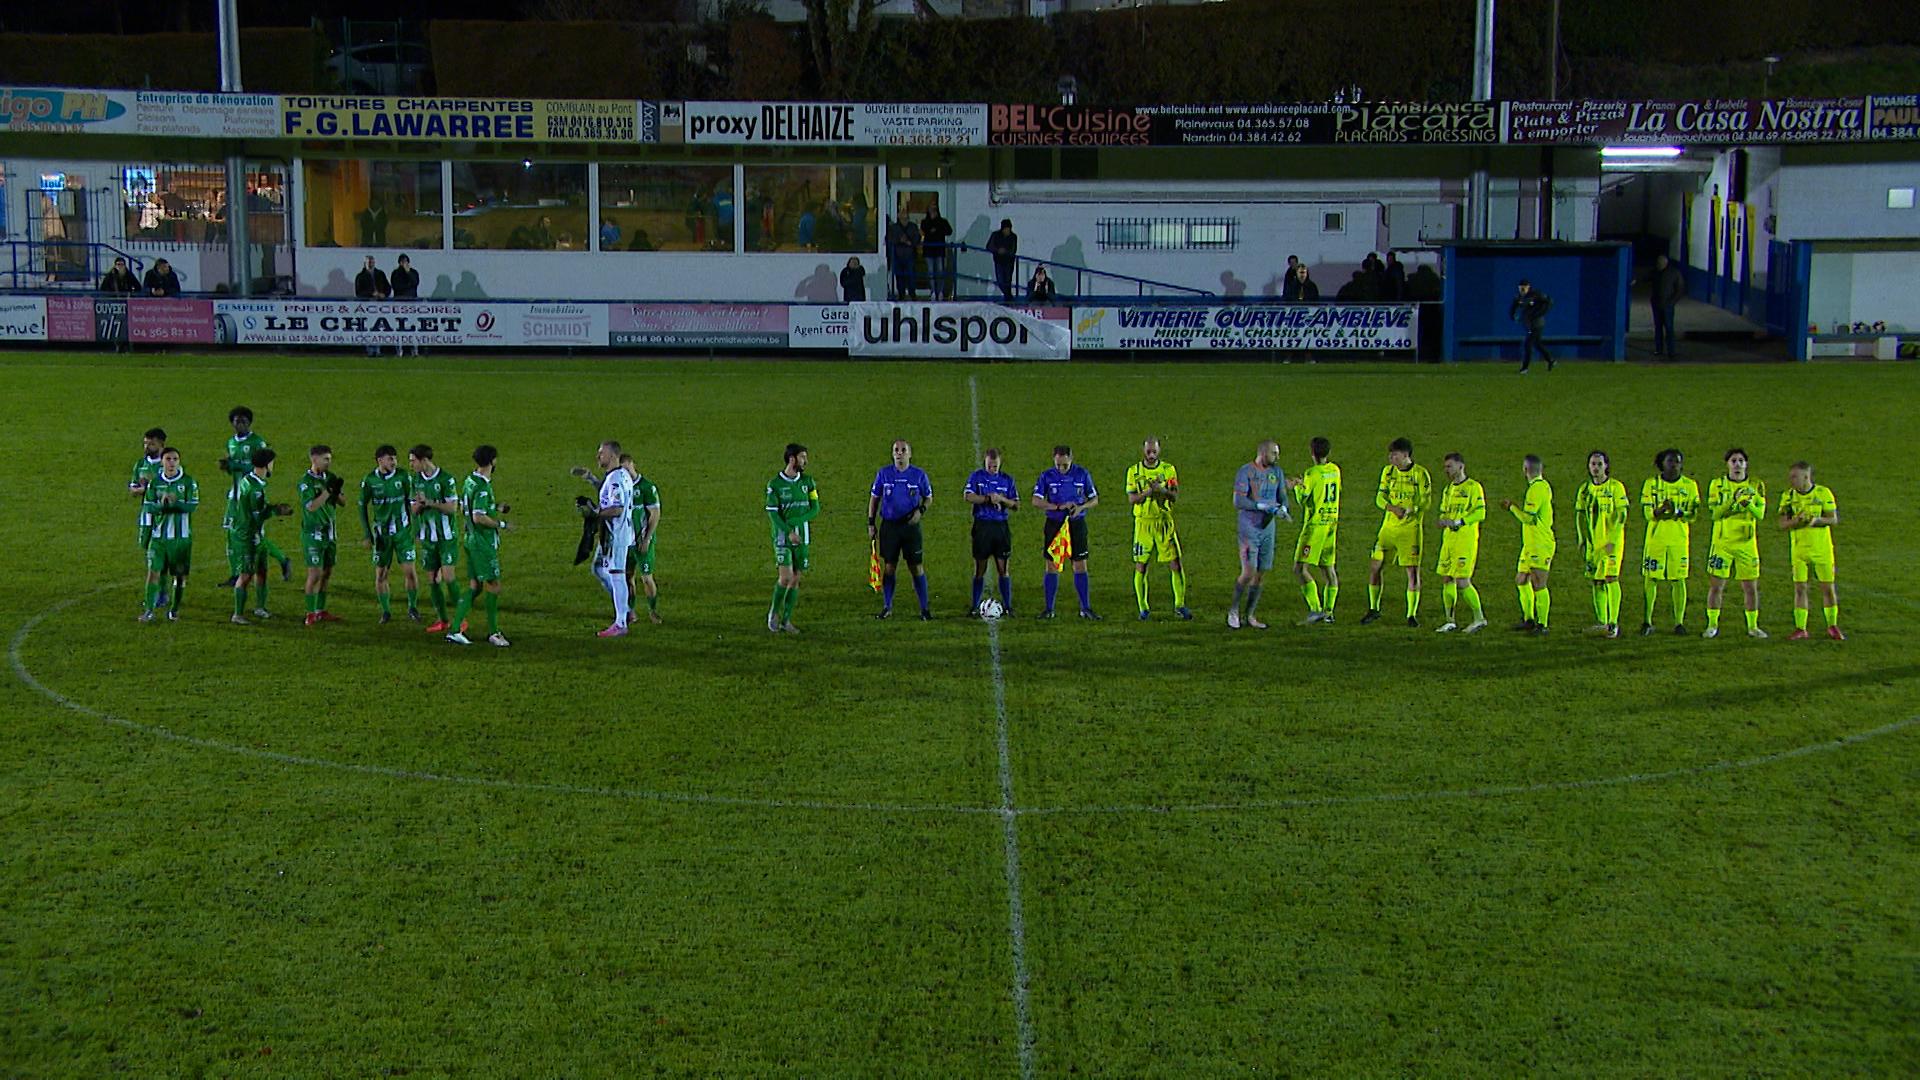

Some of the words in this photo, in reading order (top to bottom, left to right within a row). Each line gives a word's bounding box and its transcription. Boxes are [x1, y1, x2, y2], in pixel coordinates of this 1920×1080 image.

[136, 91, 194, 105] Entreprise
[196, 95, 210, 104] de
[1873, 96, 1917, 107] VIDANGE
[285, 97, 386, 110] TOITURES
[397, 100, 534, 113] CHARPENTES
[865, 105, 900, 114] OUVERT
[903, 105, 911, 114] le
[913, 105, 954, 114] dimanche
[957, 106, 980, 114] matin
[1374, 102, 1486, 114] AMBIANCE
[1511, 100, 1573, 112] Restaurant
[641, 100, 656, 142] proxy
[882, 118, 914, 126] VASTE
[917, 118, 963, 126] PARKING
[1335, 107, 1496, 131] Placard
[1556, 111, 1571, 124] &
[1625, 102, 1667, 133] La
[1675, 102, 1750, 132] Casa
[1754, 99, 1861, 132] Nostra
[690, 115, 758, 140] proxy
[761, 105, 854, 141] DELHAIZE
[1174, 119, 1234, 129] Plainevaux
[1237, 118, 1310, 129] 04.365.57.08
[991, 132, 1063, 145] CUISINES
[1182, 133, 1226, 143] Nandrin
[1228, 131, 1302, 143] 04.384.42.62
[1334, 130, 1408, 142] PLACARDS
[1422, 130, 1497, 143] DRESSING
[96, 303, 127, 315] OUVERT
[217, 304, 275, 312] SEMPERIT
[284, 304, 335, 313] PNEUS
[338, 305, 349, 313] &
[353, 304, 461, 314] ACCESSOIRES
[264, 316, 309, 331] LE
[320, 316, 462, 332] CHALET
[1118, 309, 1209, 329] VITRERIE
[101, 315, 122, 340] 7/7
[522, 321, 592, 338] SCHMIDT
[794, 325, 822, 335] Agent
[1154, 328, 1231, 338] MIROITERIE
[1244, 329, 1298, 338] CHASSIS
[1303, 329, 1331, 338] PVC
[1334, 329, 1344, 338] &
[1348, 329, 1378, 338] ALU
[243, 334, 286, 342] AYWAILLE
[351, 335, 400, 343] LOCATION
[401, 335, 414, 343] DE
[1119, 339, 1193, 348] SPRIMONT
[1210, 339, 1302, 349] 0474.920.157
[1315, 339, 1412, 348] 0495.10.94.40
[1324, 482, 1337, 503] 13
